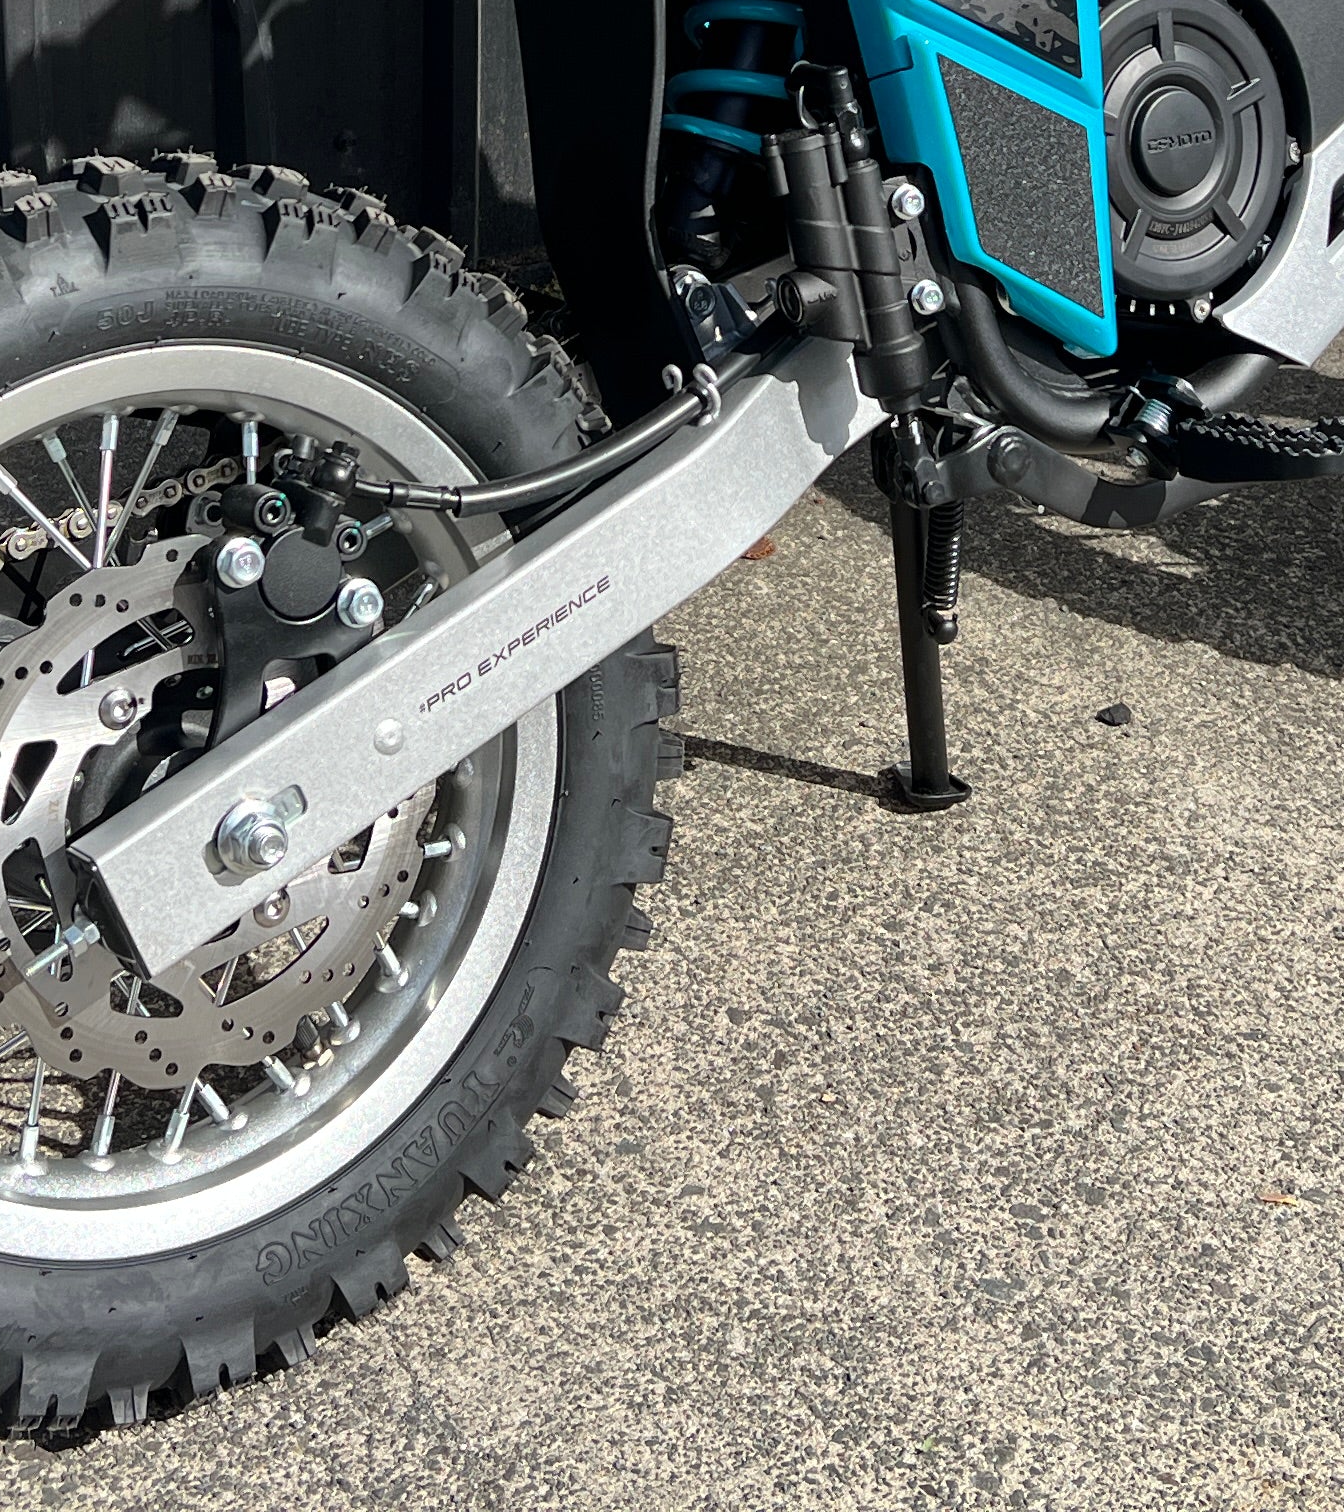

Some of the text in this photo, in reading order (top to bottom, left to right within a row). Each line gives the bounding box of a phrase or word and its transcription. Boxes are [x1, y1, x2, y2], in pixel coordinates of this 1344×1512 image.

[419, 575, 610, 713] #PRO EXPERIENCE
[256, 1070, 501, 1286] YUANXING
